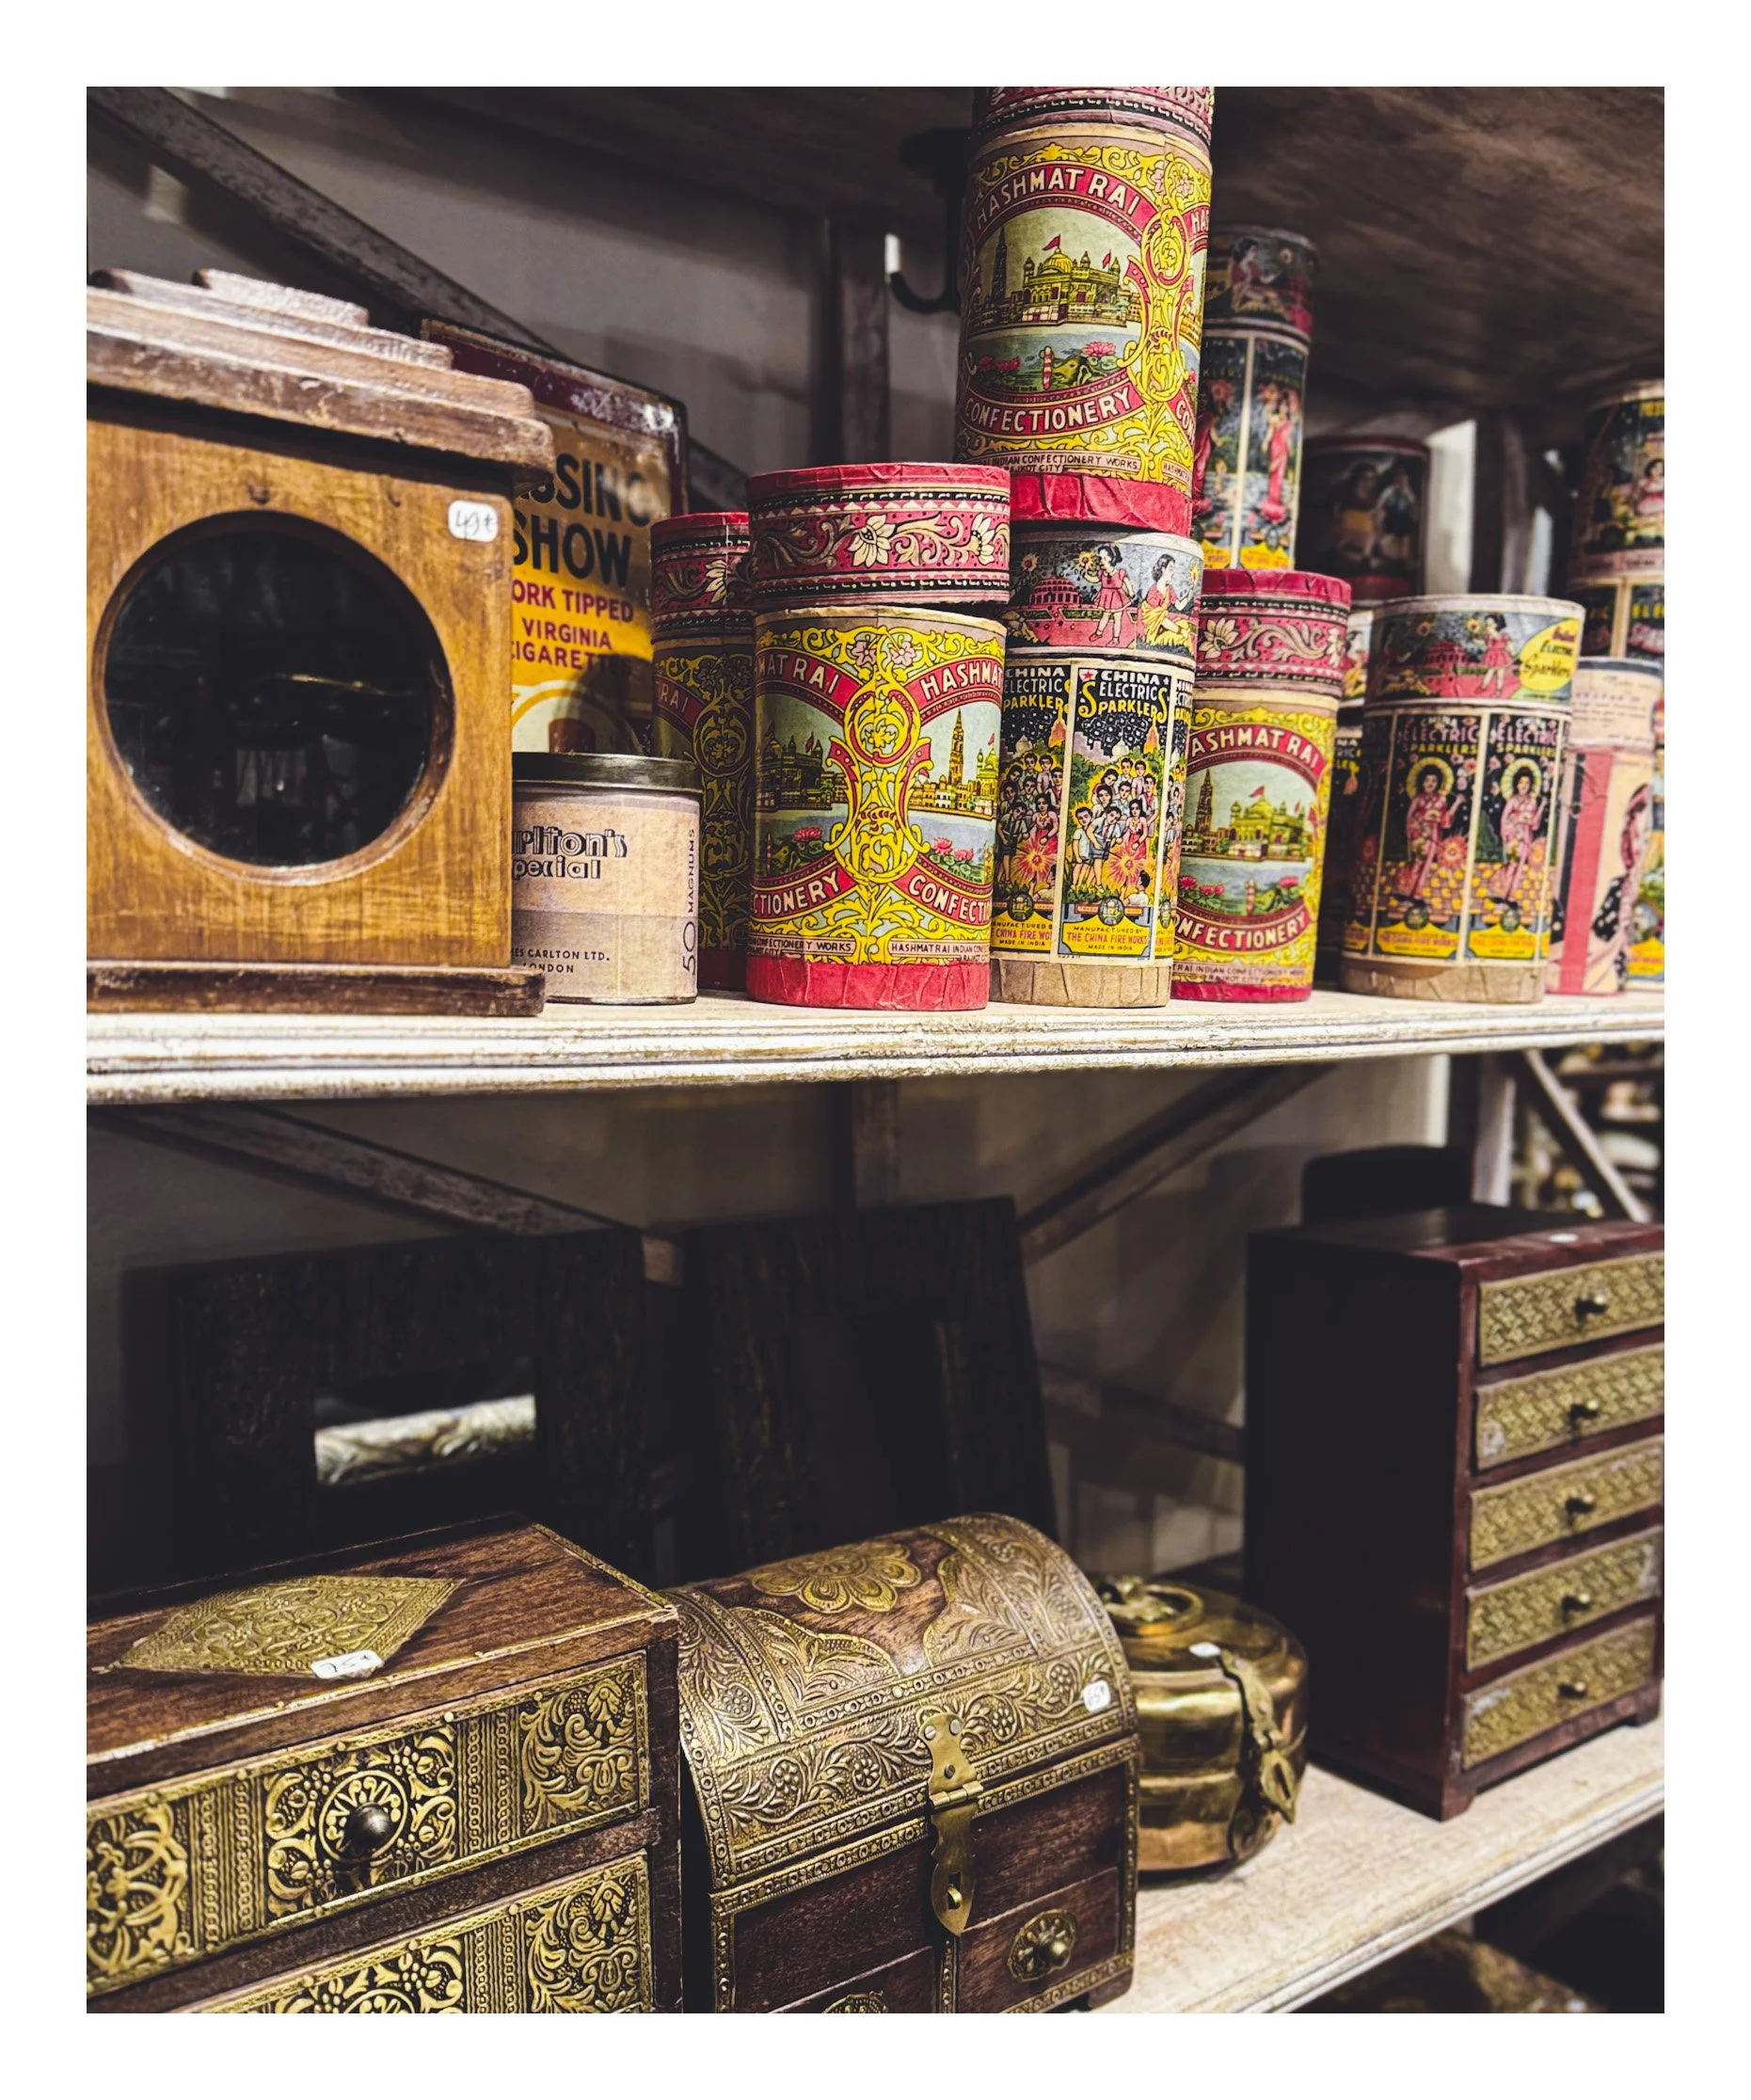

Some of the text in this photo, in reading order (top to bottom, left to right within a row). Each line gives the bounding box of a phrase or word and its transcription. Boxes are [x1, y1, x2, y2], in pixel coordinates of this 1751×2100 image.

[976, 167, 1141, 231] HASHMAT RAI
[964, 387, 1132, 433] CONFECTIONERY
[1022, 454, 1102, 466] CONFECTIONERY
[513, 508, 632, 588] SHOW
[562, 587, 635, 624] TIPPED
[522, 617, 613, 649] VIRGINIA
[792, 658, 840, 694] RAI
[920, 660, 1003, 701] HASHMAT
[1004, 678, 1062, 693] ELECTRIC
[1005, 666, 1065, 677] CHINA
[1101, 670, 1161, 686] CHINA
[660, 682, 689, 713] RAI
[1079, 680, 1168, 724] SPARKLERS
[1099, 678, 1158, 700] ELECTRIC
[1190, 725, 1318, 770] ASHMAT RAI
[682, 828, 697, 976] 50 MAGNUMS
[1019, 929, 1037, 940] FIRE
[1066, 931, 1082, 942] THE
[1085, 932, 1108, 944] CHINA
[1110, 933, 1126, 945] FIRE
[1073, 925, 1134, 934] MANUFACTURED
[511, 947, 611, 962] ES CARLTON LTD.
[1195, 964, 1224, 974] INDIAN
